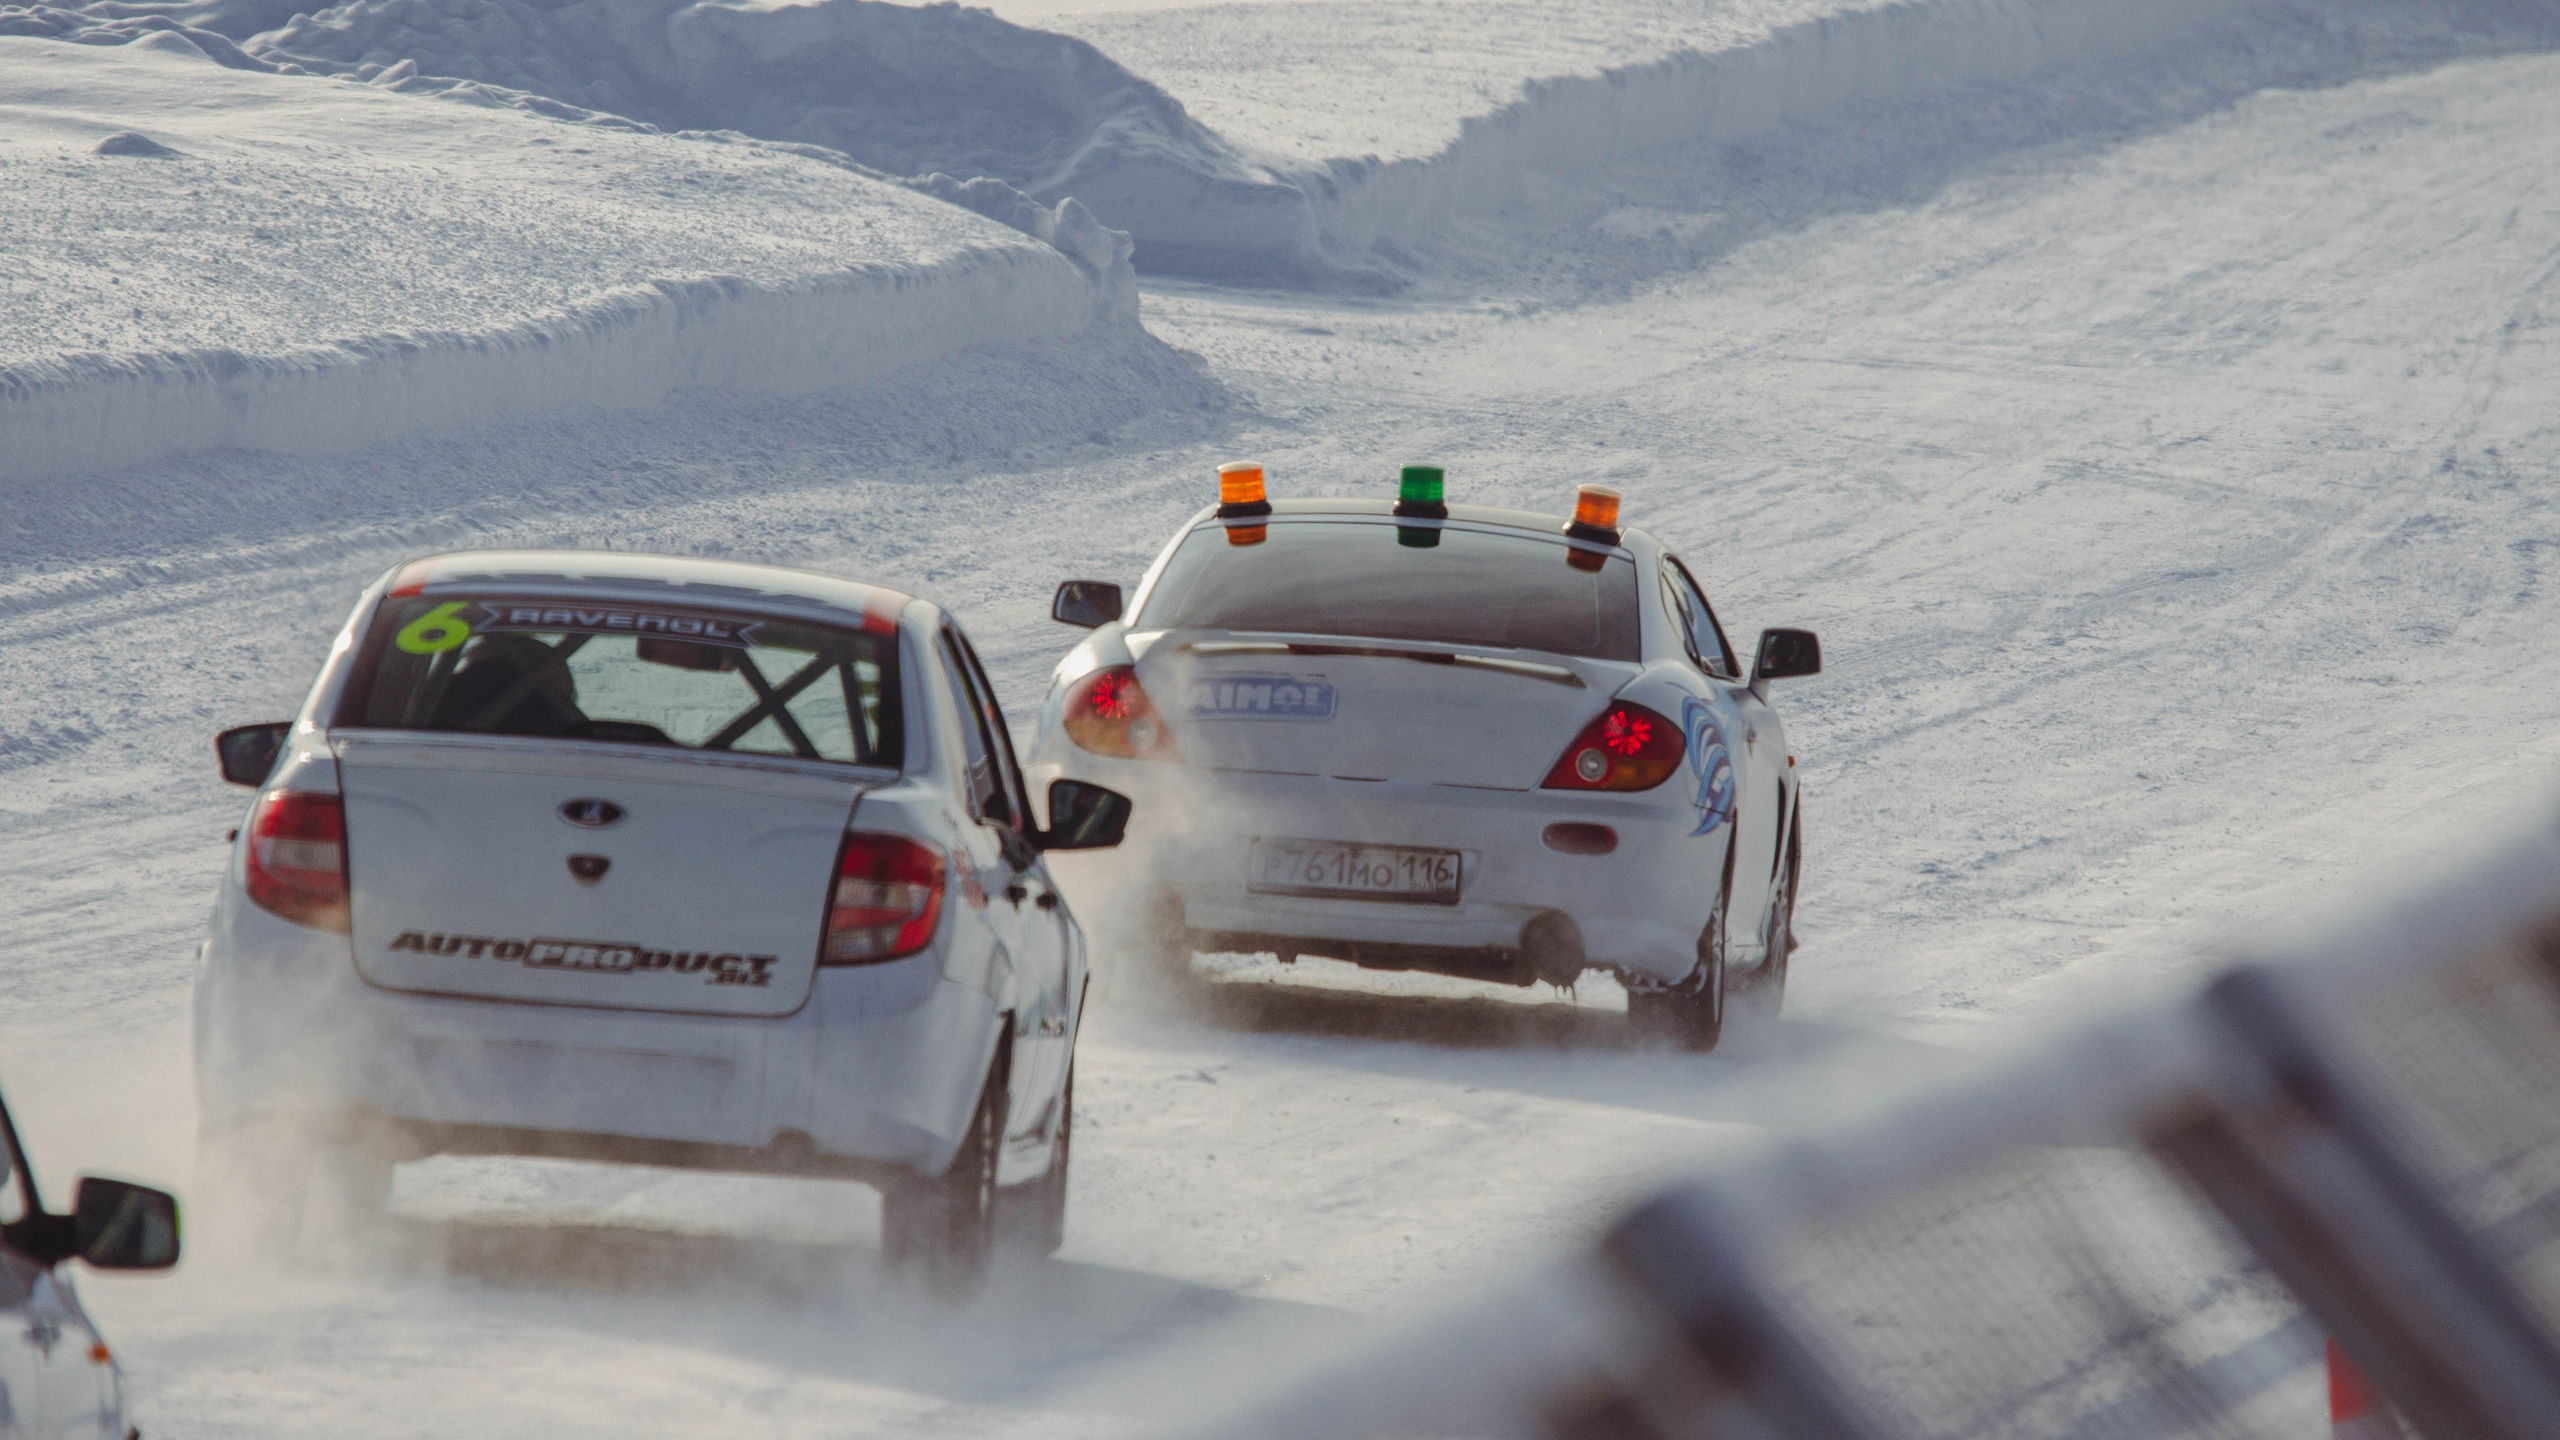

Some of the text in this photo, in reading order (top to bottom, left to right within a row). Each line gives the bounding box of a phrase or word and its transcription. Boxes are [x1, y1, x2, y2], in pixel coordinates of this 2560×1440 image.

[395, 601, 471, 654] 6
[1189, 683, 1327, 711] AIMOL
[1402, 855, 1449, 883] 116
